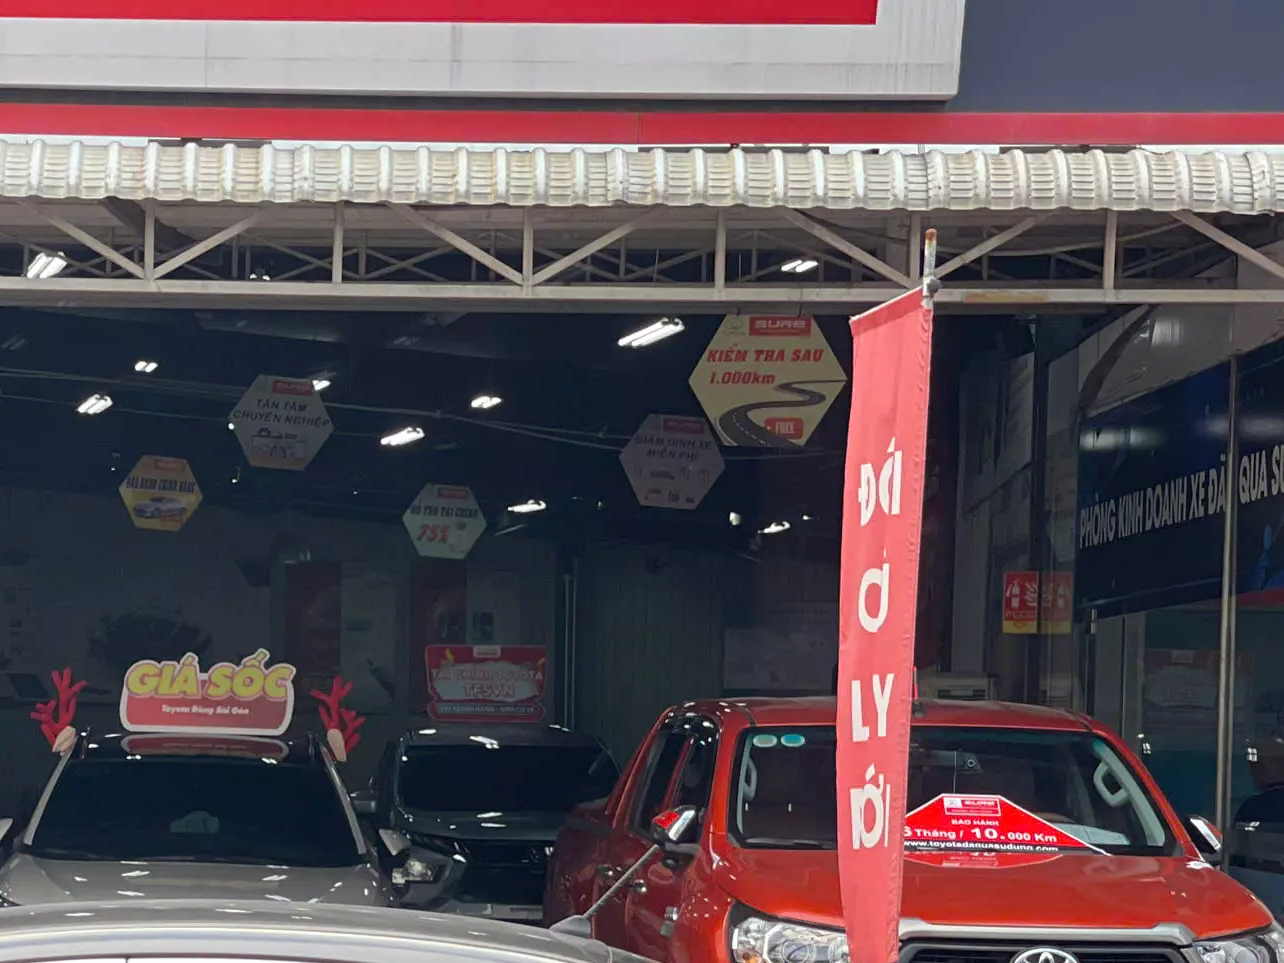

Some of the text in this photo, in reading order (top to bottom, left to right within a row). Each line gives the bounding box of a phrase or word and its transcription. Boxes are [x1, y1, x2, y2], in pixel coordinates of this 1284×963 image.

[755, 320, 807, 329] SURE
[754, 349, 786, 362] TRA
[790, 349, 824, 362] SAU
[710, 371, 775, 385] 1.000km
[1079, 493, 1116, 549] PHÒNG
[1118, 491, 1144, 539] KINH
[1146, 476, 1187, 531] DOANH
[1189, 471, 1206, 520] XE
[1239, 450, 1268, 504] QUA
[127, 650, 293, 698] GIÁ SỐC
[915, 828, 956, 839] Tháng
[1034, 834, 1058, 843] Km
